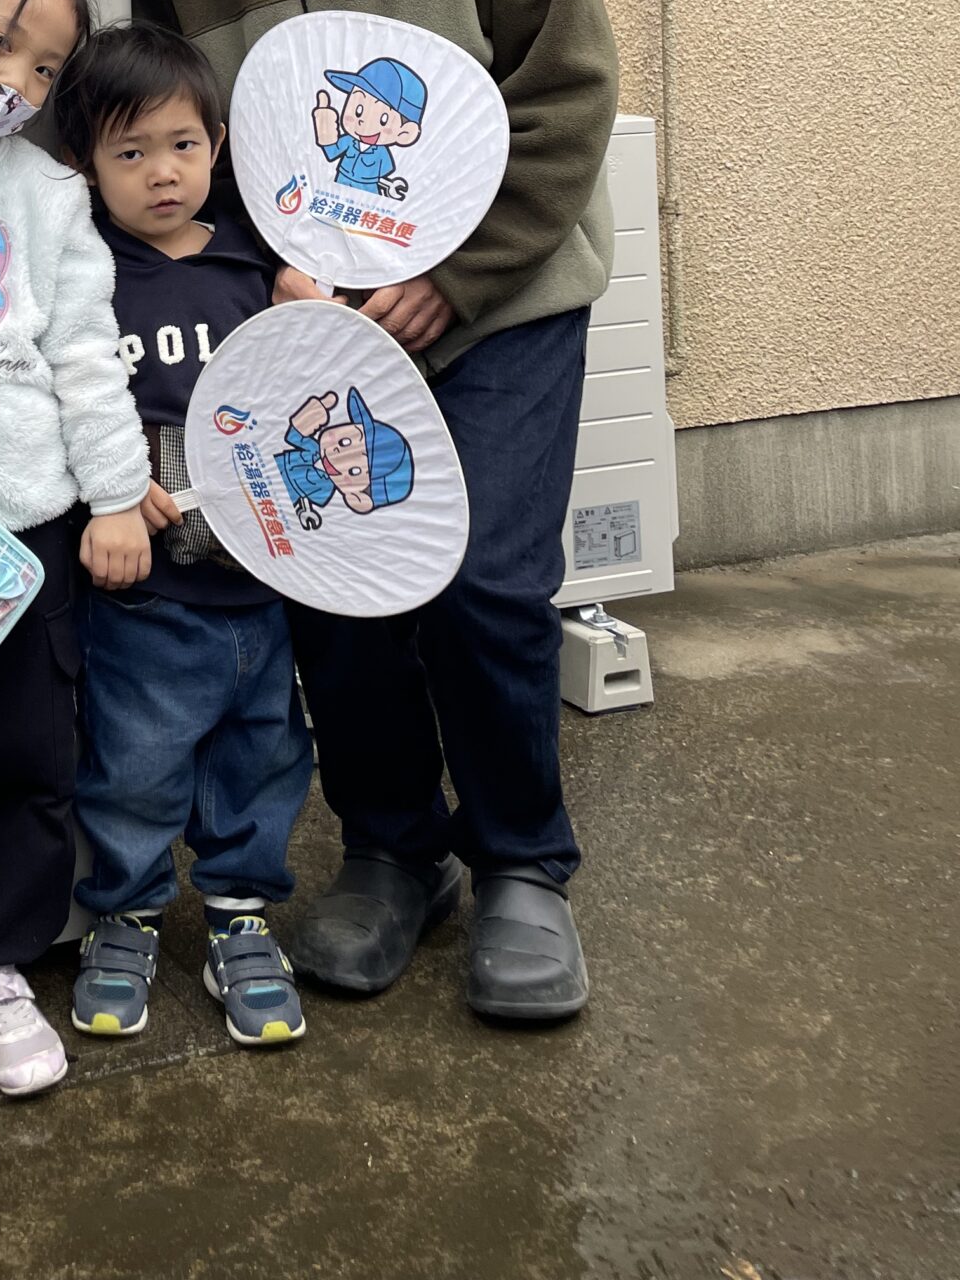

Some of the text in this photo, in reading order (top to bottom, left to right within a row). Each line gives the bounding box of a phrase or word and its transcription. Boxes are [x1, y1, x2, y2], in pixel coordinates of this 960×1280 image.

[308, 196, 419, 241] 給湯器特急便
[234, 442, 296, 558] 給湯器特急便
